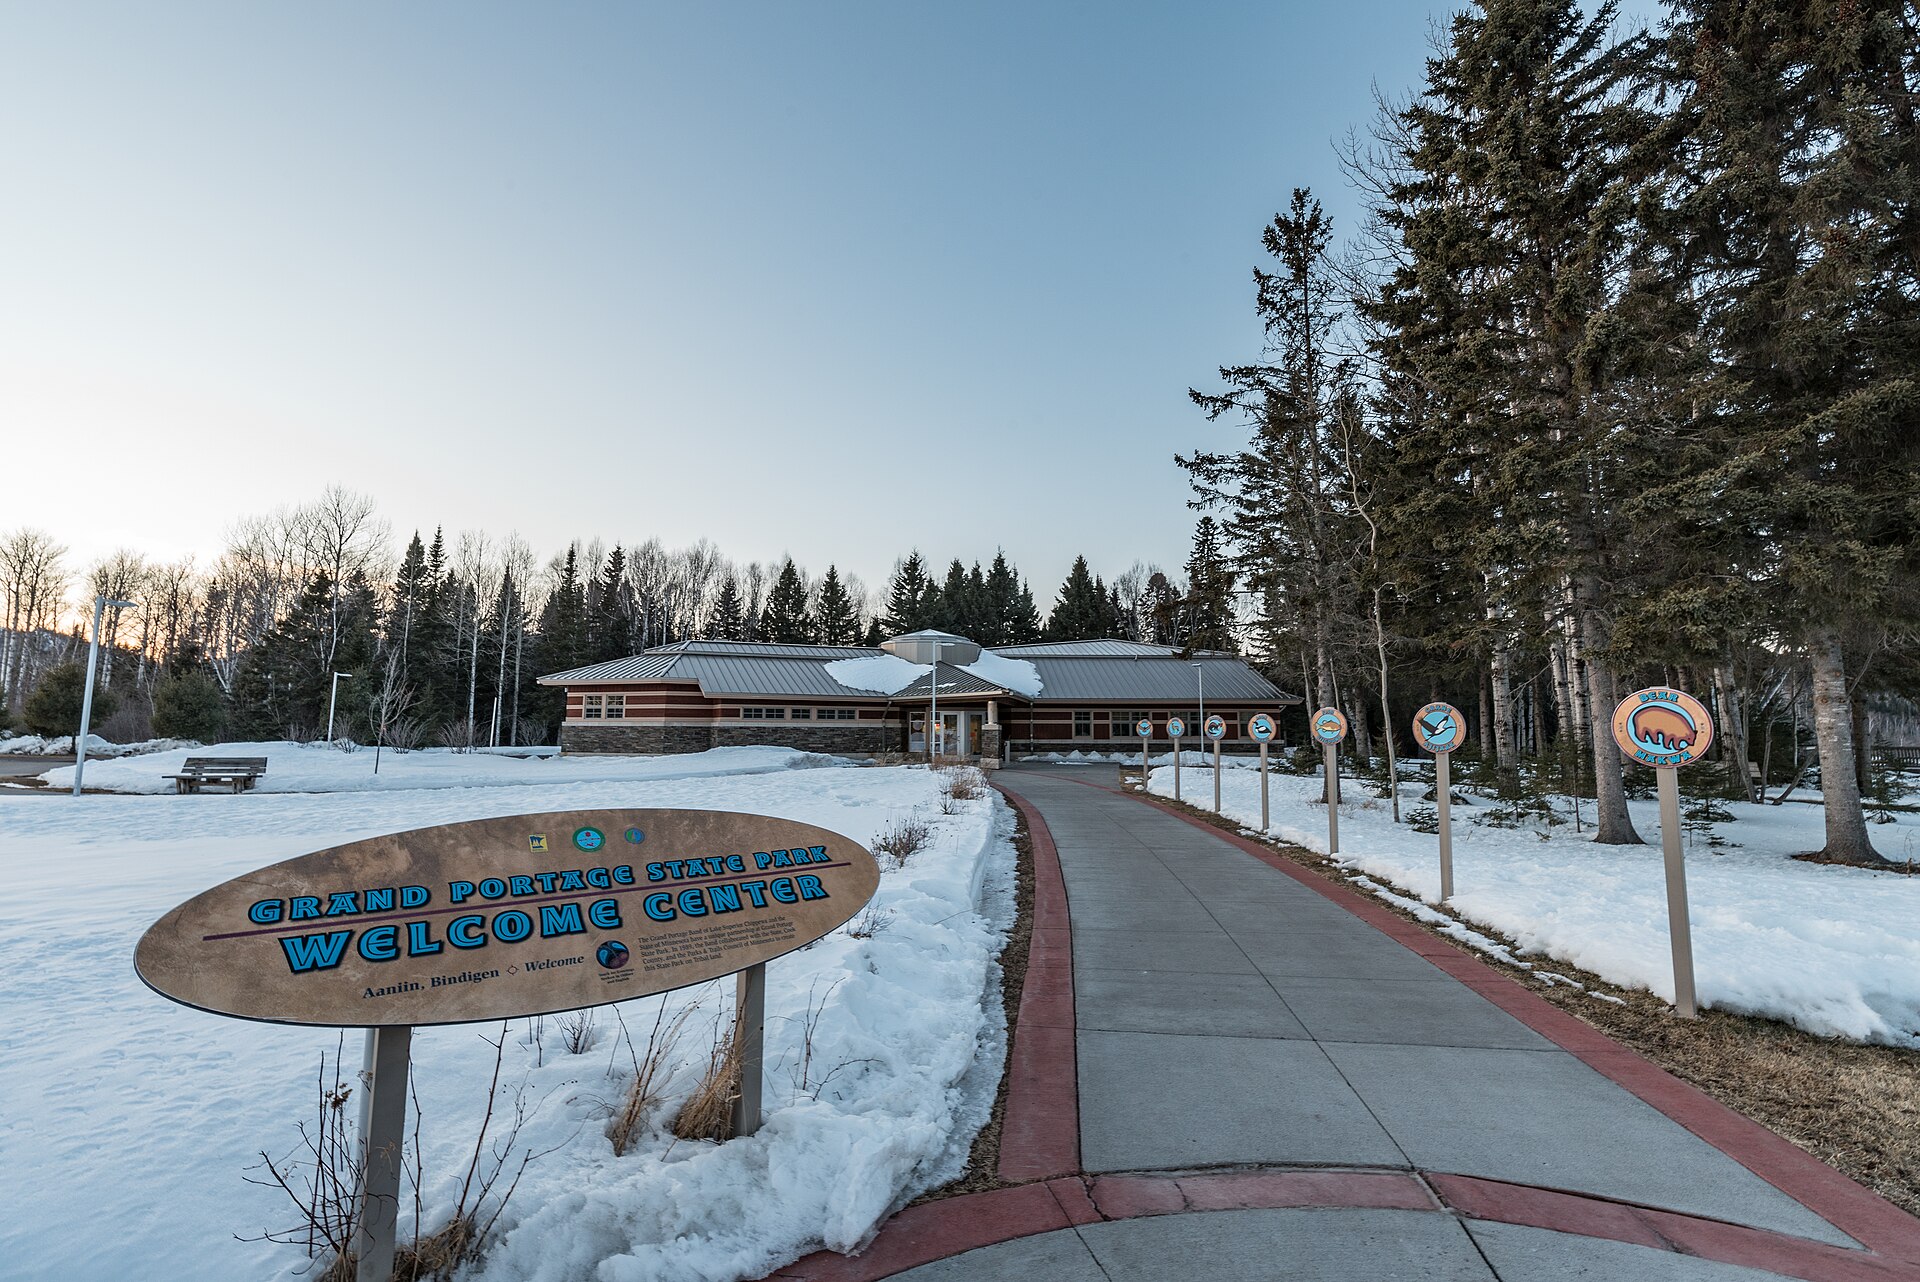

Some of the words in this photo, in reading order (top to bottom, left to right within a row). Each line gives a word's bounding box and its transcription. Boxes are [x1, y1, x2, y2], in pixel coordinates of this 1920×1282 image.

[1638, 691, 1680, 703] BEAR
[1425, 704, 1453, 714] CRANE
[1634, 749, 1693, 765] MAKWA
[248, 885, 431, 925] GRAND
[448, 865, 635, 903] PORTAGE
[646, 854, 746, 882] STATE
[752, 845, 832, 870] PARK
[278, 898, 623, 974] WELCOME
[643, 873, 830, 923] CENTER
[650, 934, 667, 942] Grand
[362, 981, 425, 999] Aaniin,
[430, 969, 500, 987] Bindigen
[524, 955, 585, 972] Welcome
